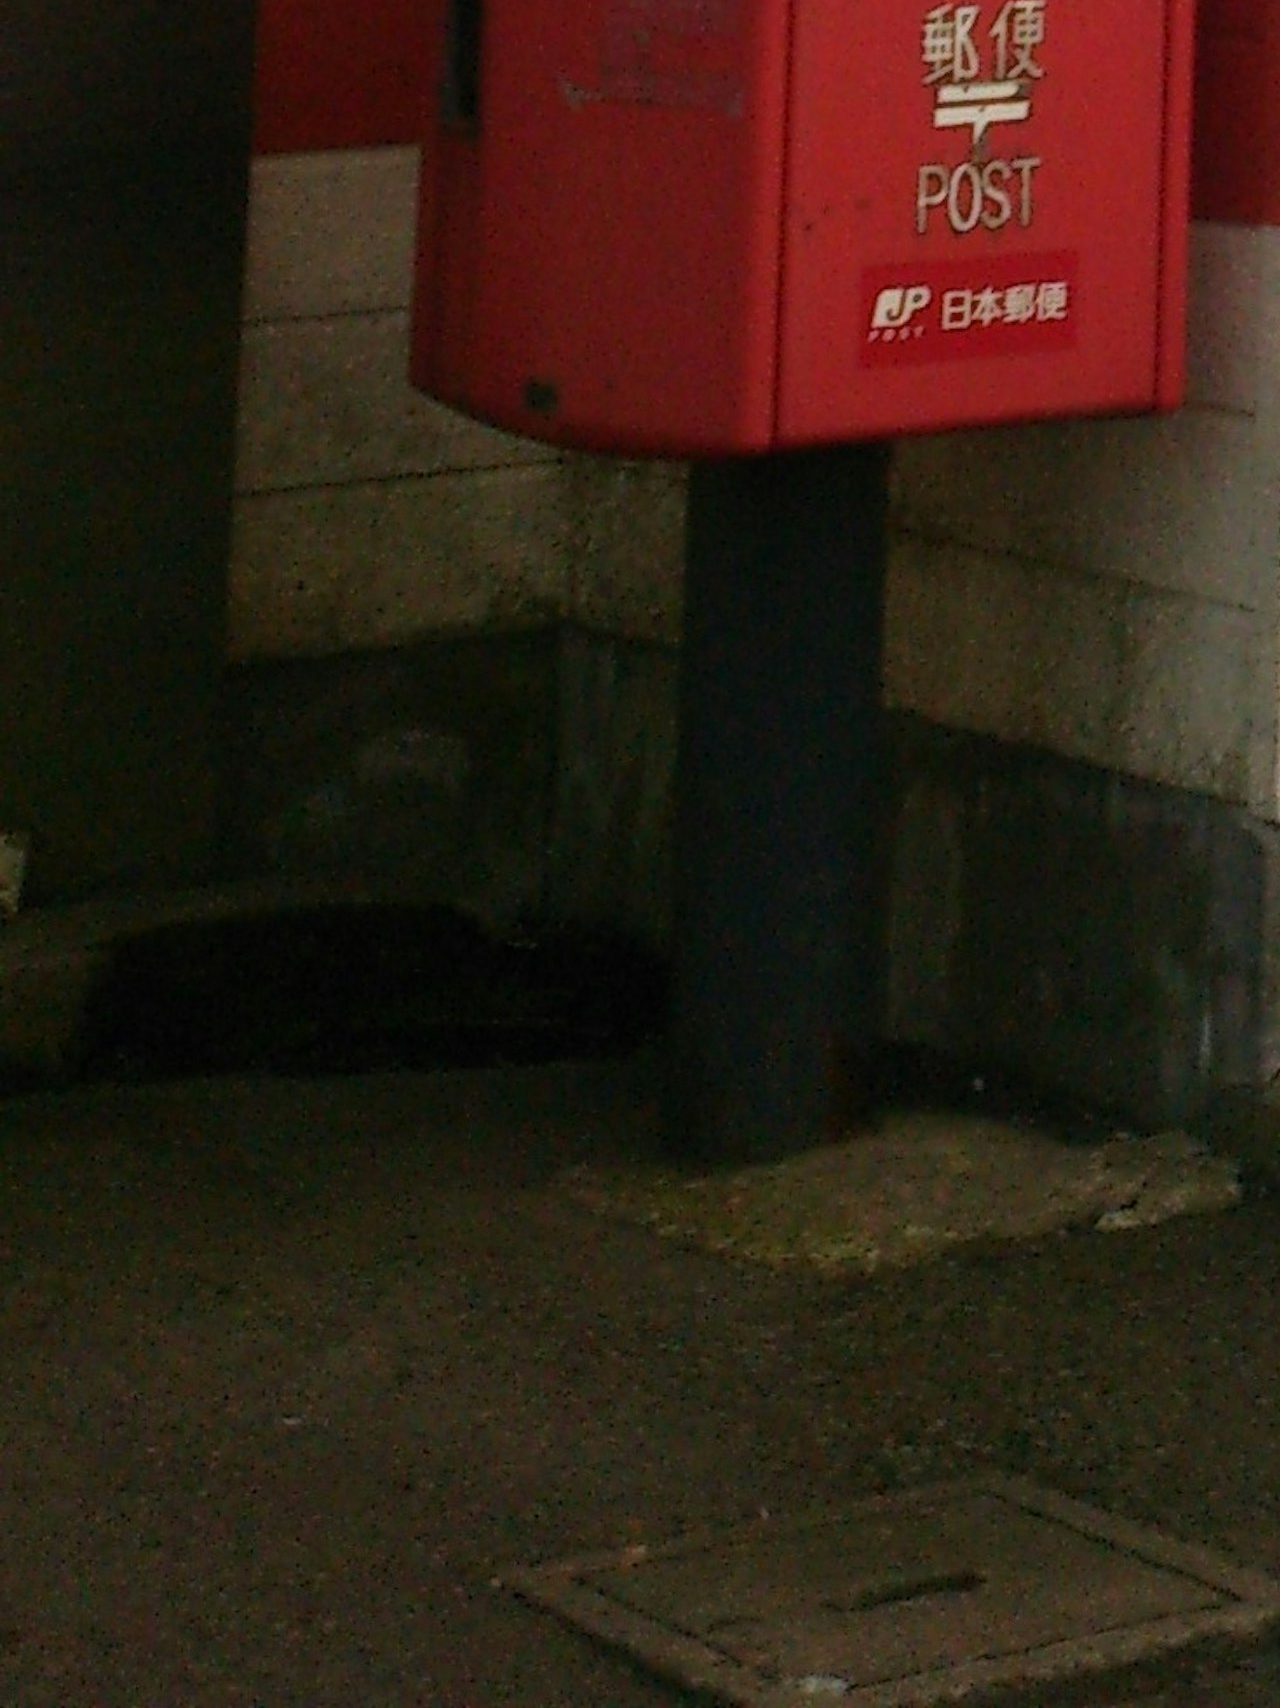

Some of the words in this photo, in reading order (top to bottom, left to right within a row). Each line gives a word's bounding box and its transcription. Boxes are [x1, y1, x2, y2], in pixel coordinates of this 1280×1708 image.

[915, 157, 1042, 234] POST
[940, 281, 1069, 330] 日本郵便
